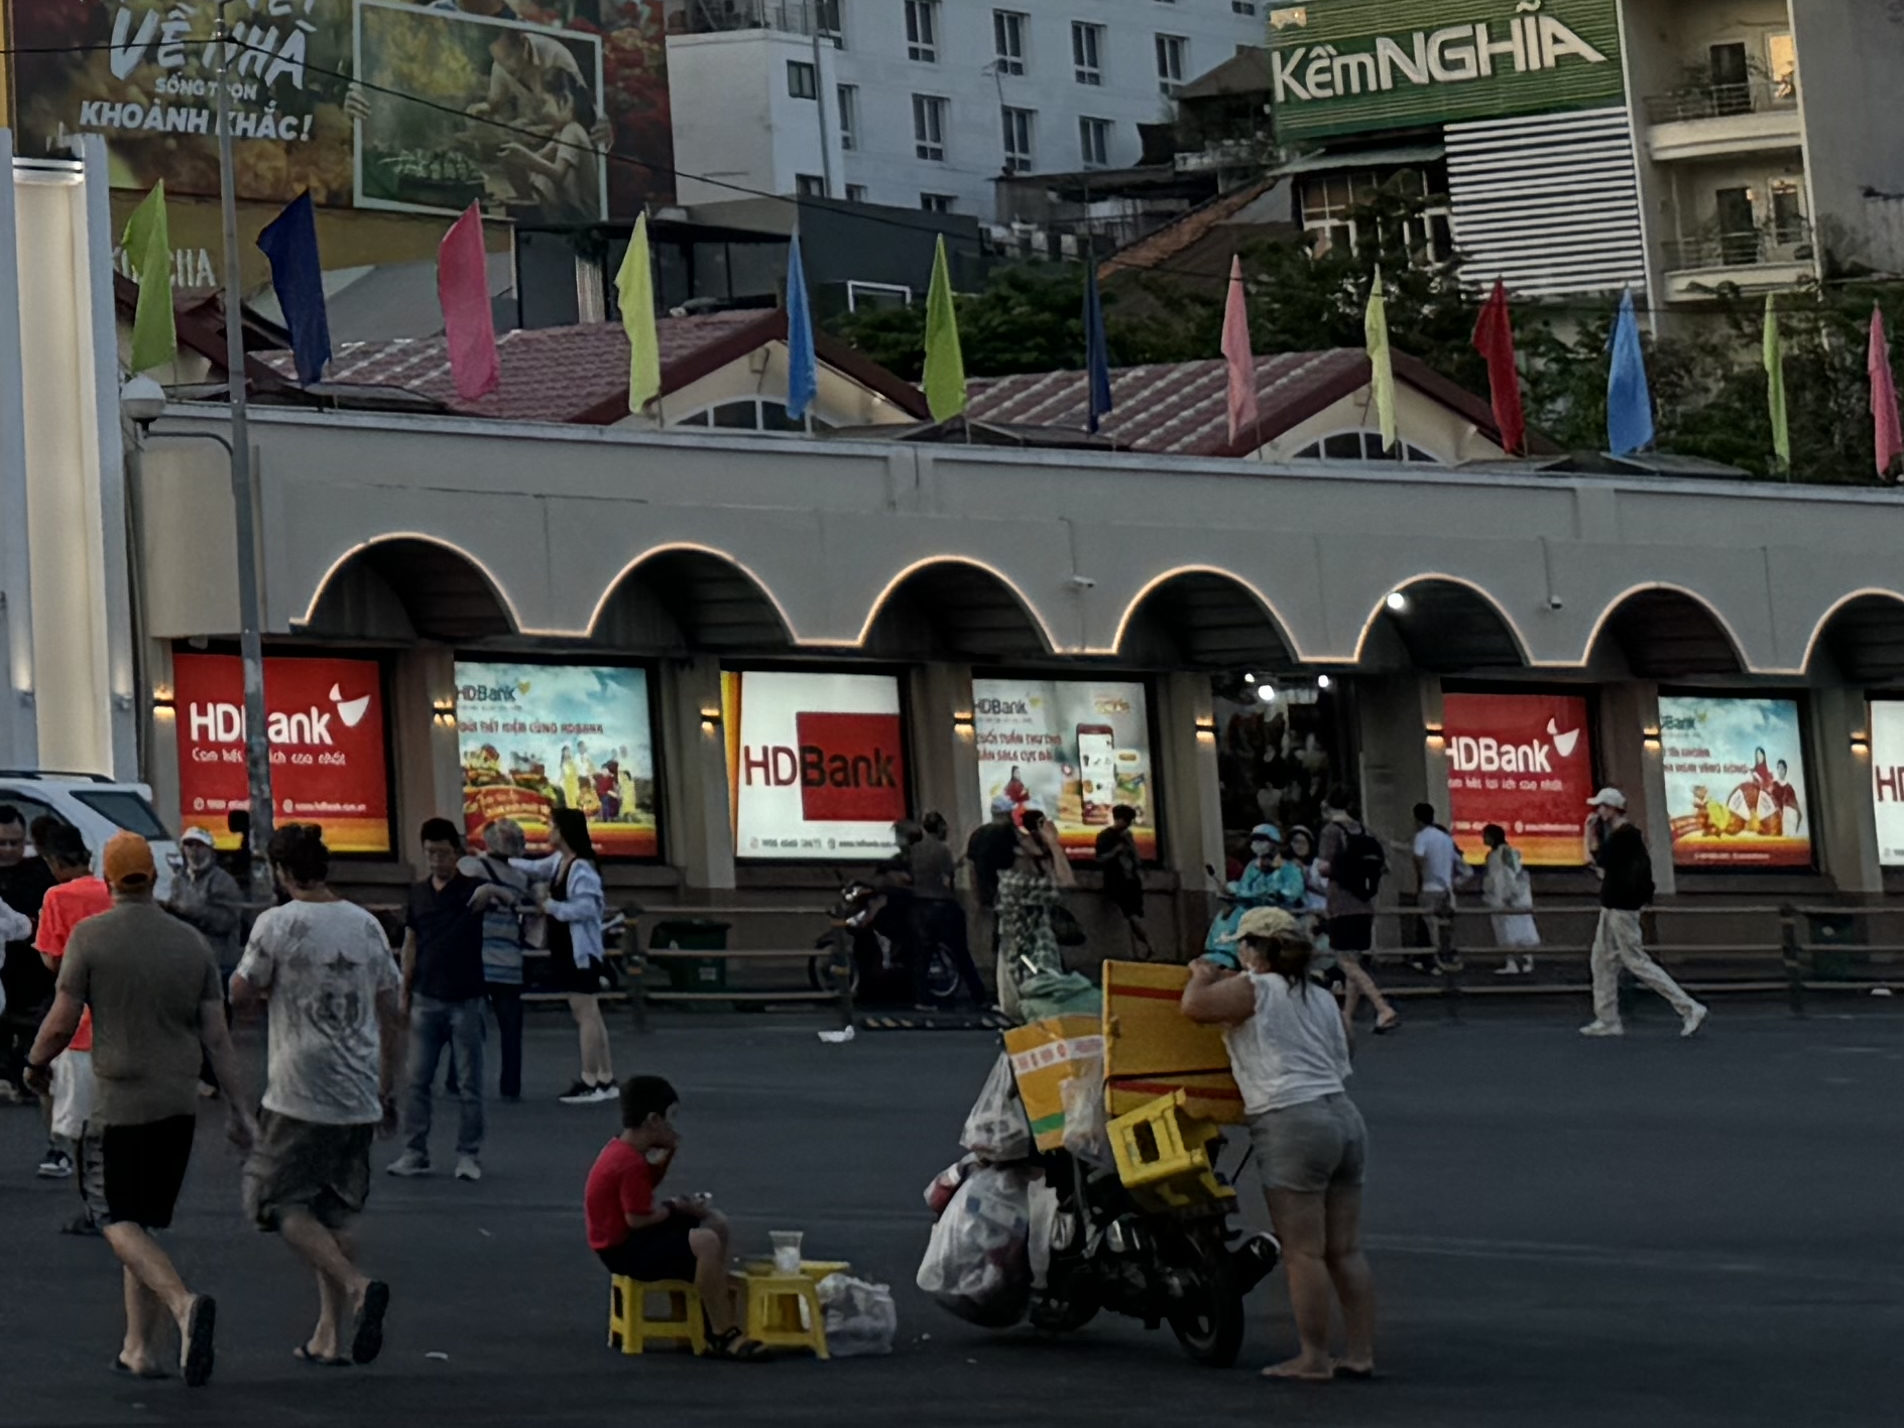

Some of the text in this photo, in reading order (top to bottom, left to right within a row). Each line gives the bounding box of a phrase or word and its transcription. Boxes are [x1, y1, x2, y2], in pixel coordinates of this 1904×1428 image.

[109, 2, 197, 82] VỀ
[206, 80, 257, 102] TỌN
[190, 702, 334, 746] HDank
[744, 745, 897, 789] HDBank
